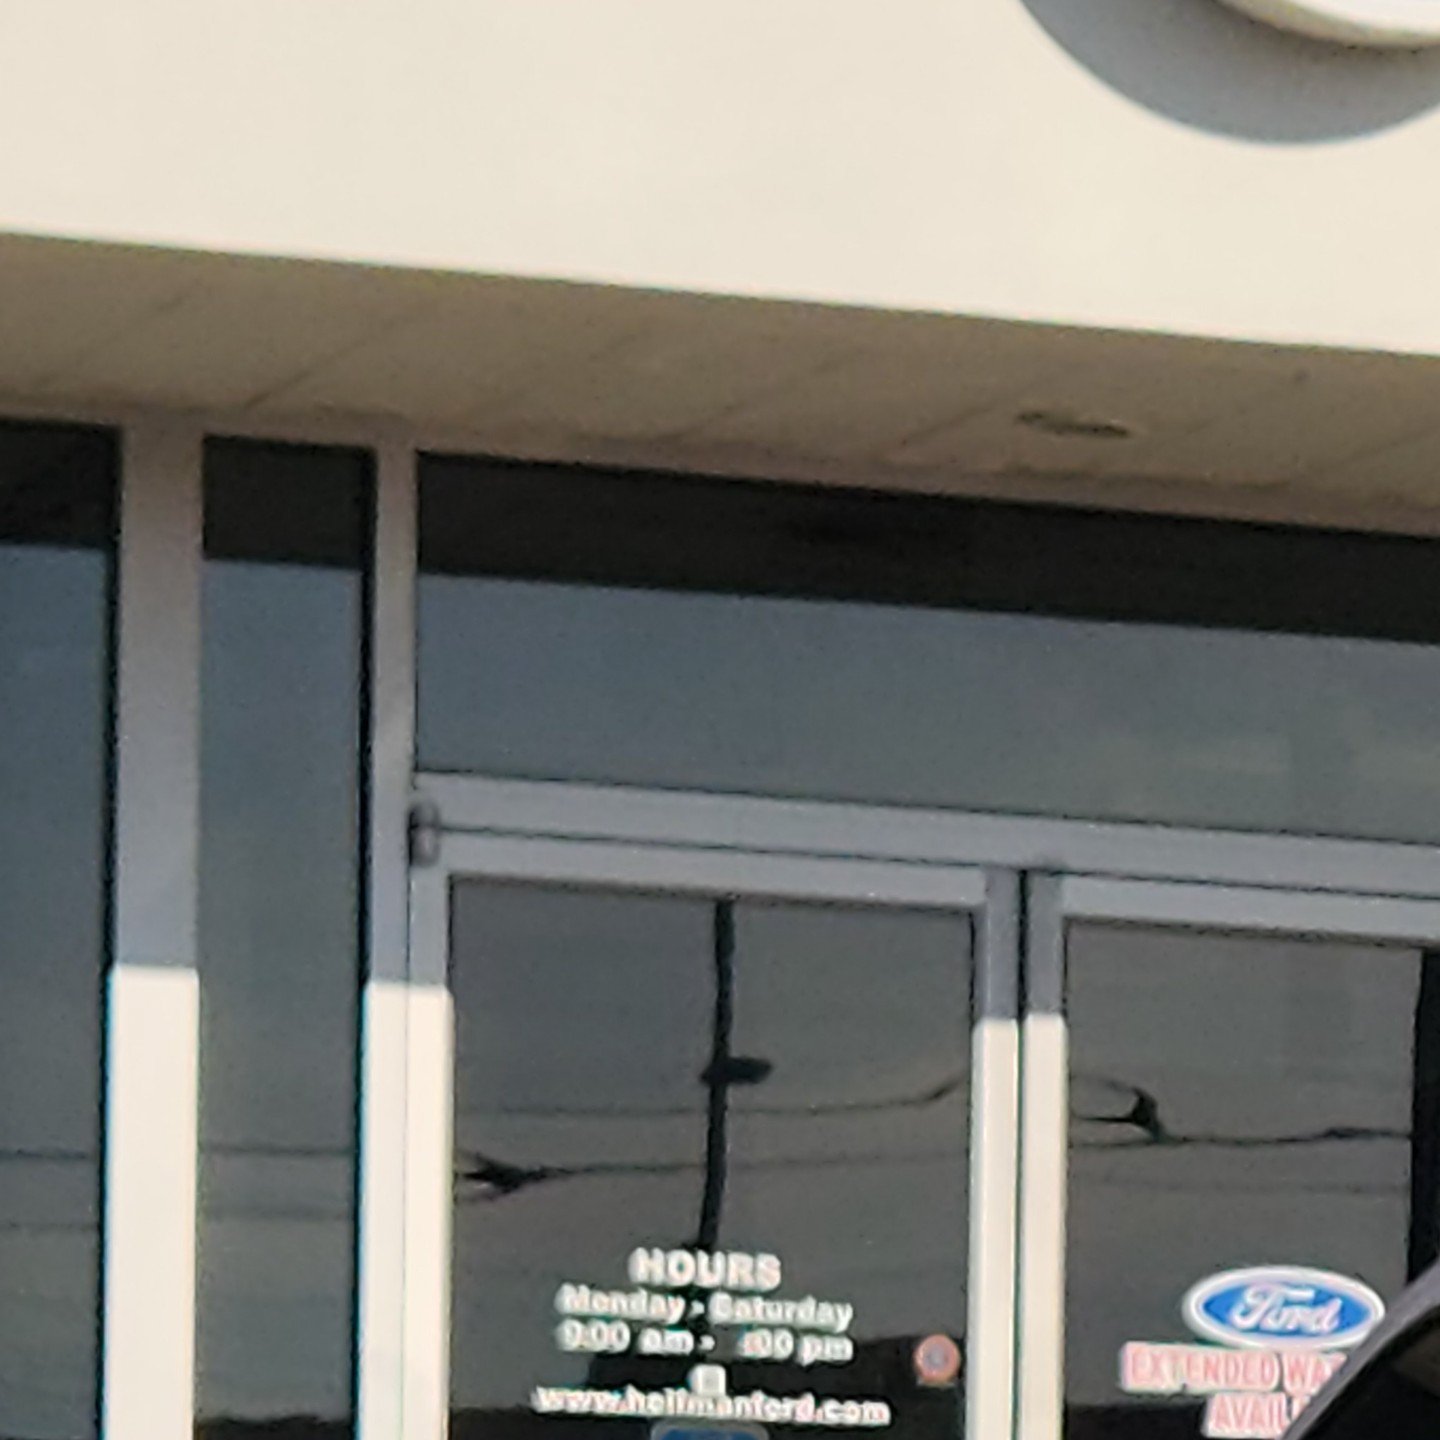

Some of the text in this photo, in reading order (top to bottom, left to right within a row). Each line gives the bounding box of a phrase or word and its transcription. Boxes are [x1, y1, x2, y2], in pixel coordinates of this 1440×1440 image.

[628, 1247, 781, 1290] HOURS
[555, 1283, 685, 1324] Monday
[708, 1291, 853, 1333] Saturday
[1229, 1282, 1343, 1334] Ford
[797, 1334, 854, 1366] pm
[1130, 1348, 1279, 1390] EXTENDED
